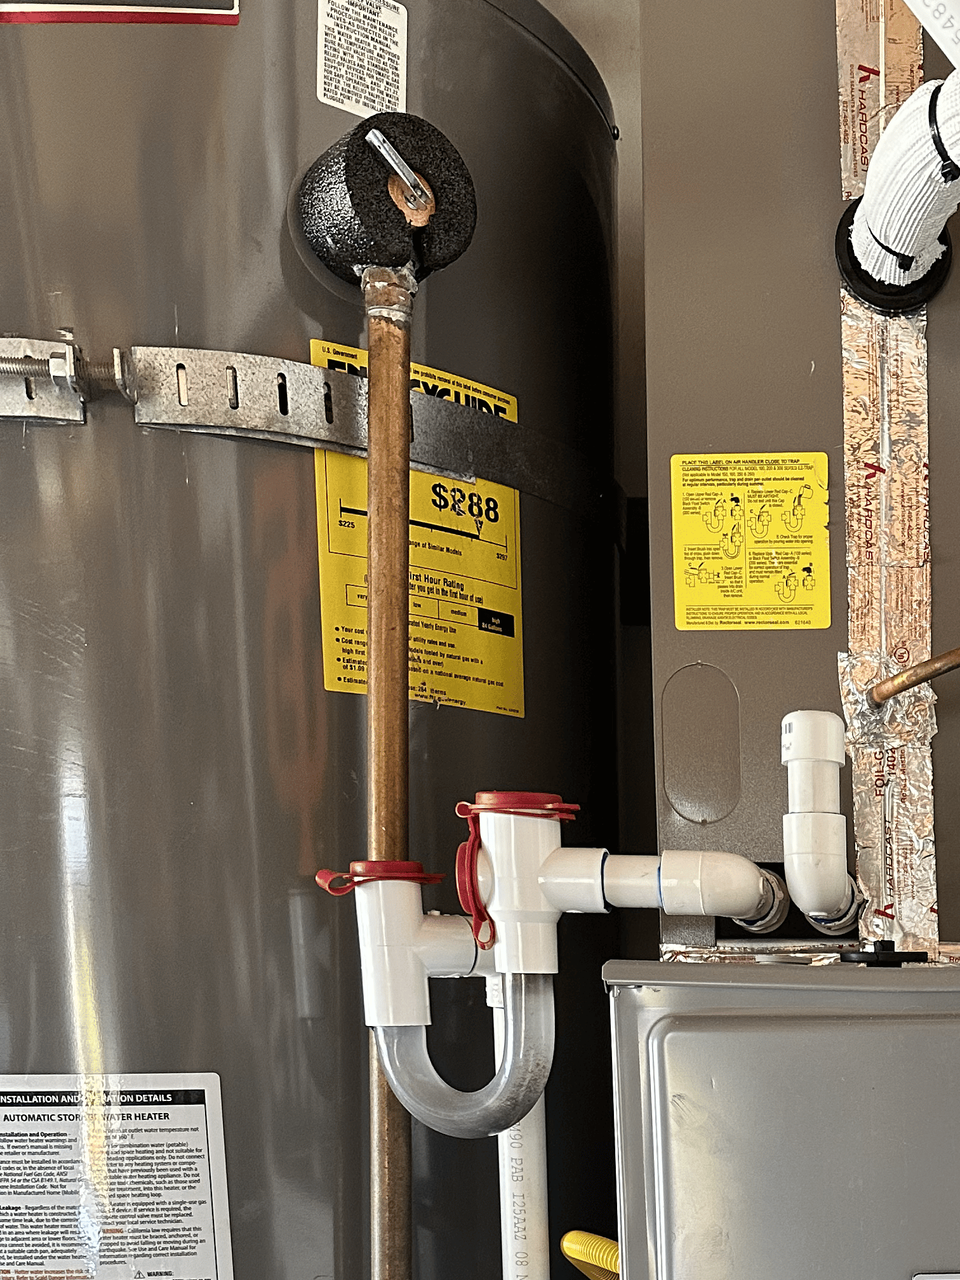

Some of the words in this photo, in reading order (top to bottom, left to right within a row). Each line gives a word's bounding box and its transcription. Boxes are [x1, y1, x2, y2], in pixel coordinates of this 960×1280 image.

[431, 482, 499, 523] $288
[338, 519, 356, 529] $225
[427, 542, 445, 552] Similar
[445, 546, 463, 557] Models
[409, 571, 422, 582] irst
[423, 573, 441, 586] Hour
[442, 577, 465, 593] Rating
[884, 819, 895, 898] HARDCAST
[0, 1095, 60, 1105] NSTALLATION
[61, 1095, 80, 1104] AND
[135, 1093, 173, 1103] DETAILS
[3, 1113, 56, 1123] AUTOMATIC
[134, 1112, 170, 1121] HEATER
